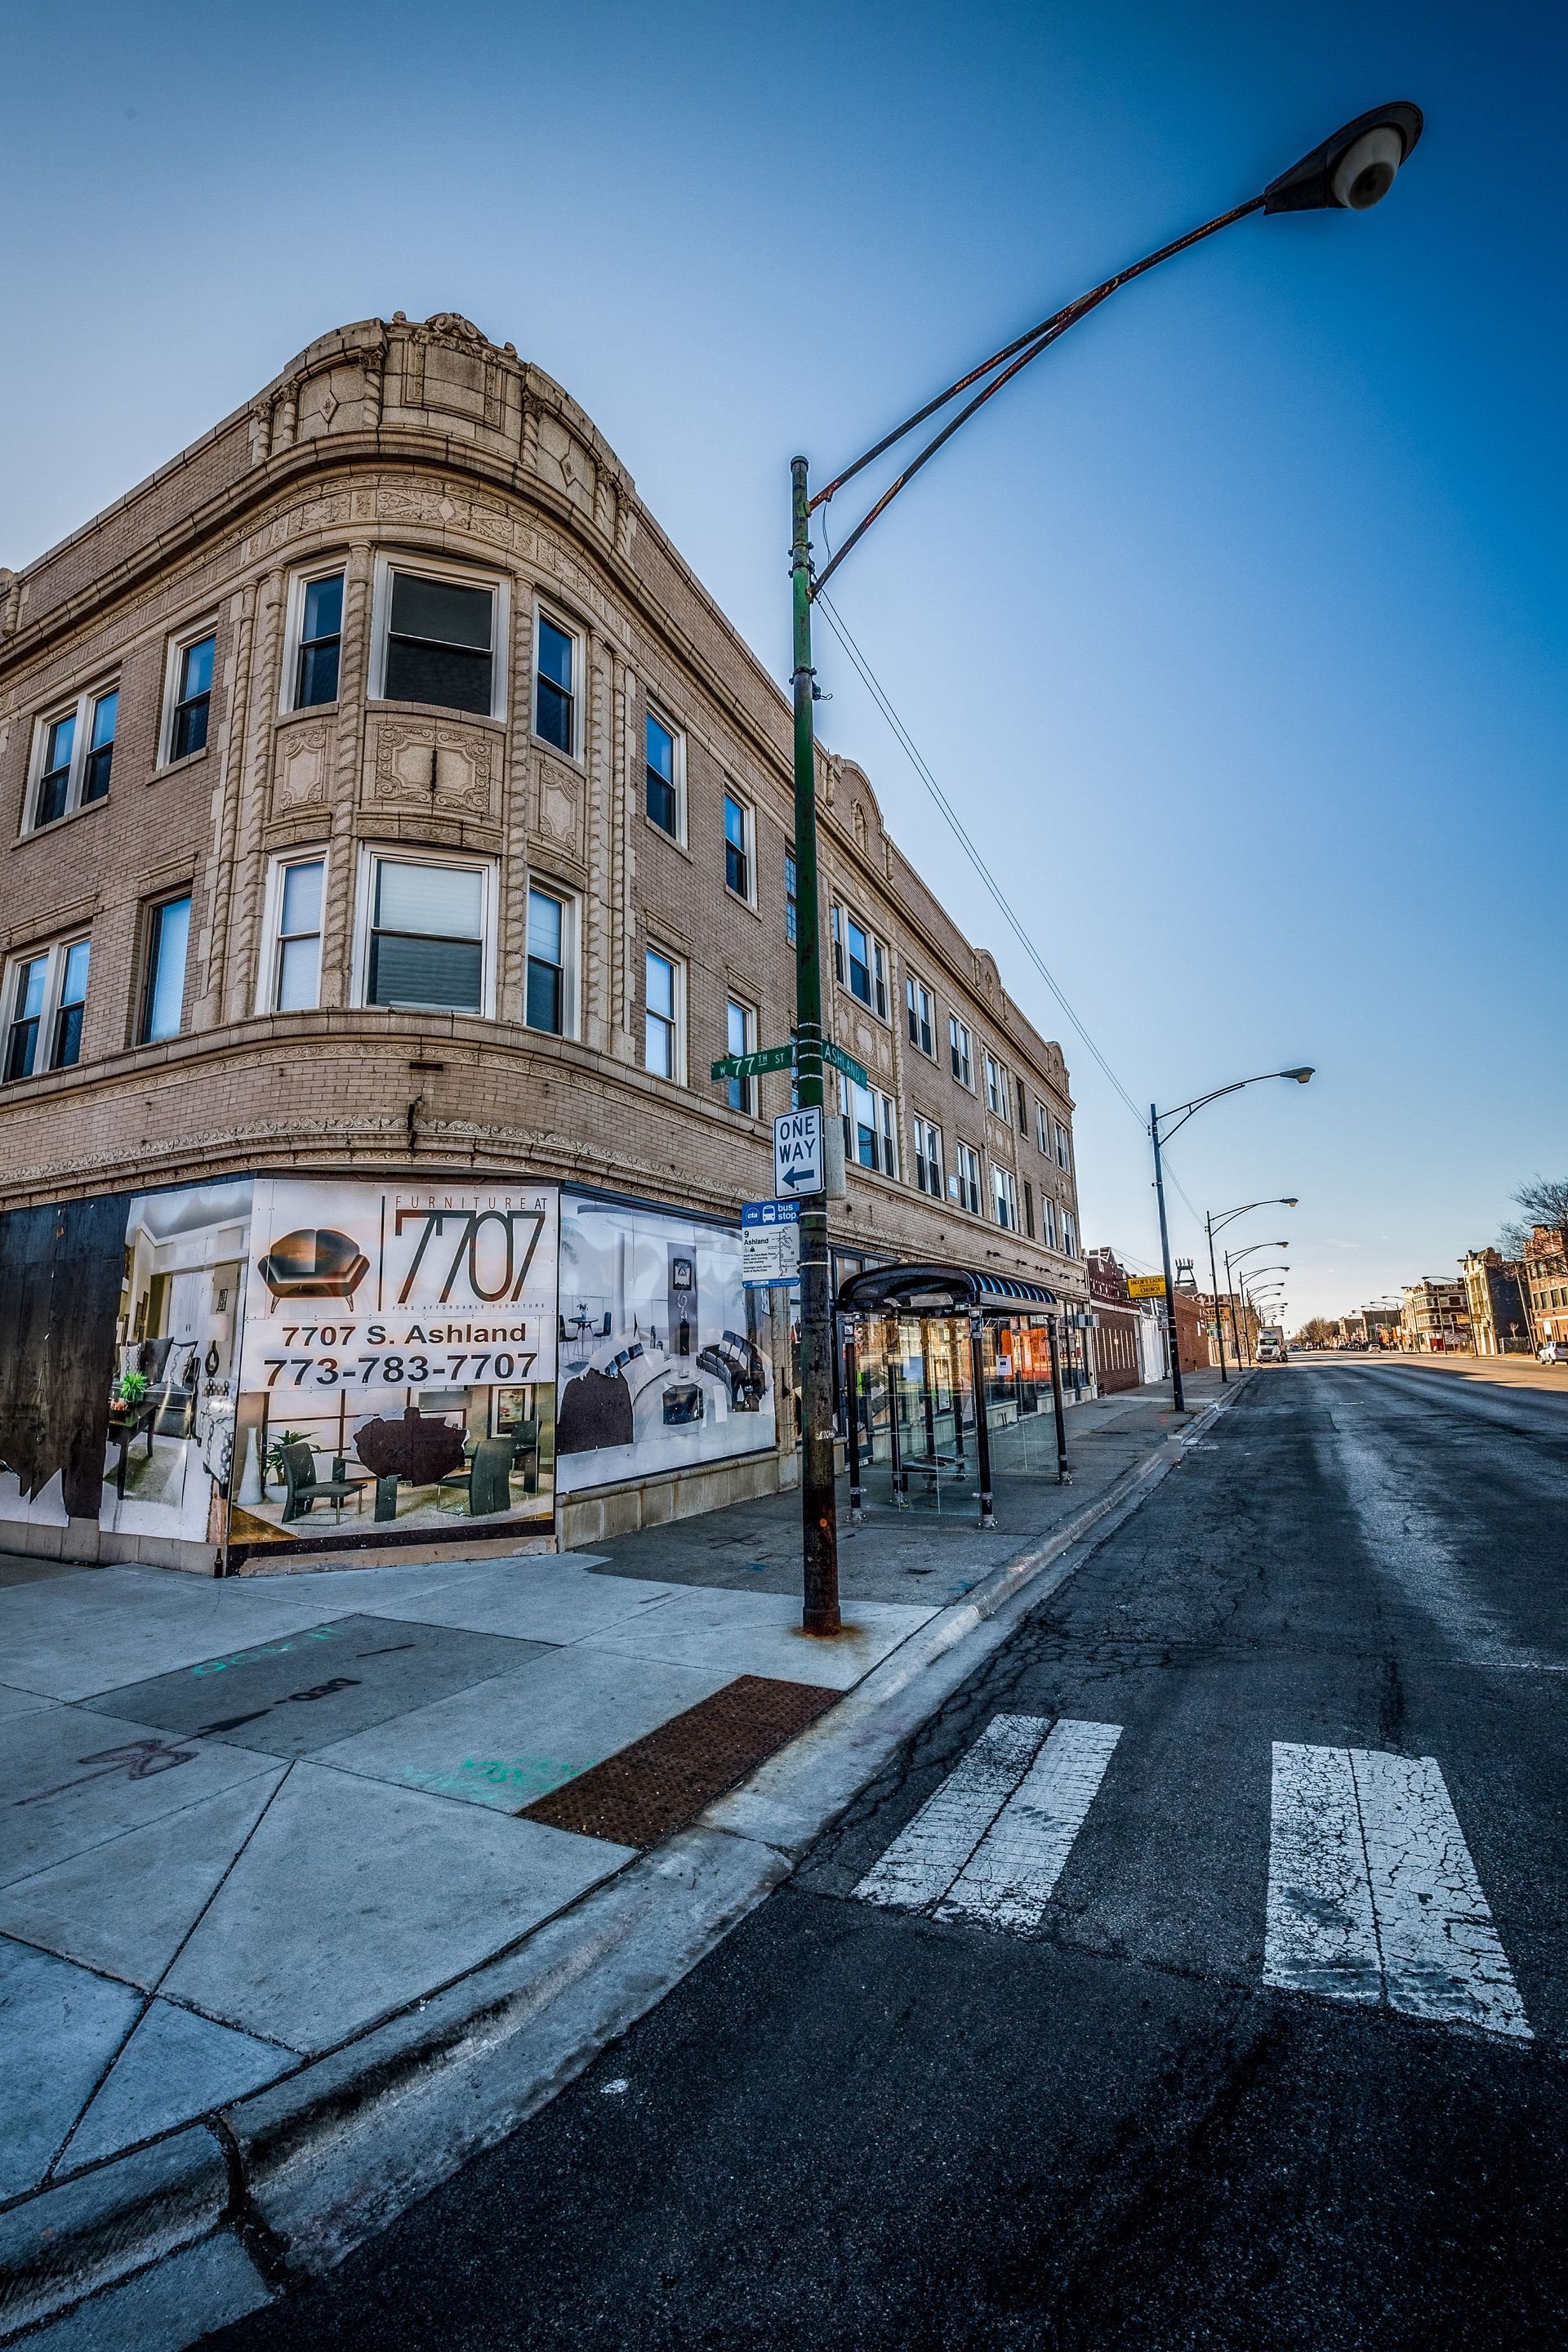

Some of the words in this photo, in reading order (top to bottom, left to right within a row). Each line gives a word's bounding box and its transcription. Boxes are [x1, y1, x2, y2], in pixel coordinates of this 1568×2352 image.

[719, 1067, 726, 1076] W
[775, 1054, 785, 1064] ST
[824, 1045, 860, 1081] ASHLAND
[780, 1116, 815, 1141] ONE
[779, 1138, 817, 1164] WAY
[395, 1196, 526, 1210] FURNITURE
[534, 1197, 548, 1210] AT
[777, 1211, 797, 1221] stop
[394, 1209, 546, 1304] 7707
[282, 1326, 356, 1348] 7707
[366, 1325, 395, 1345] S.
[404, 1322, 527, 1345] Ashland
[263, 1352, 537, 1387] 773-783-7707
